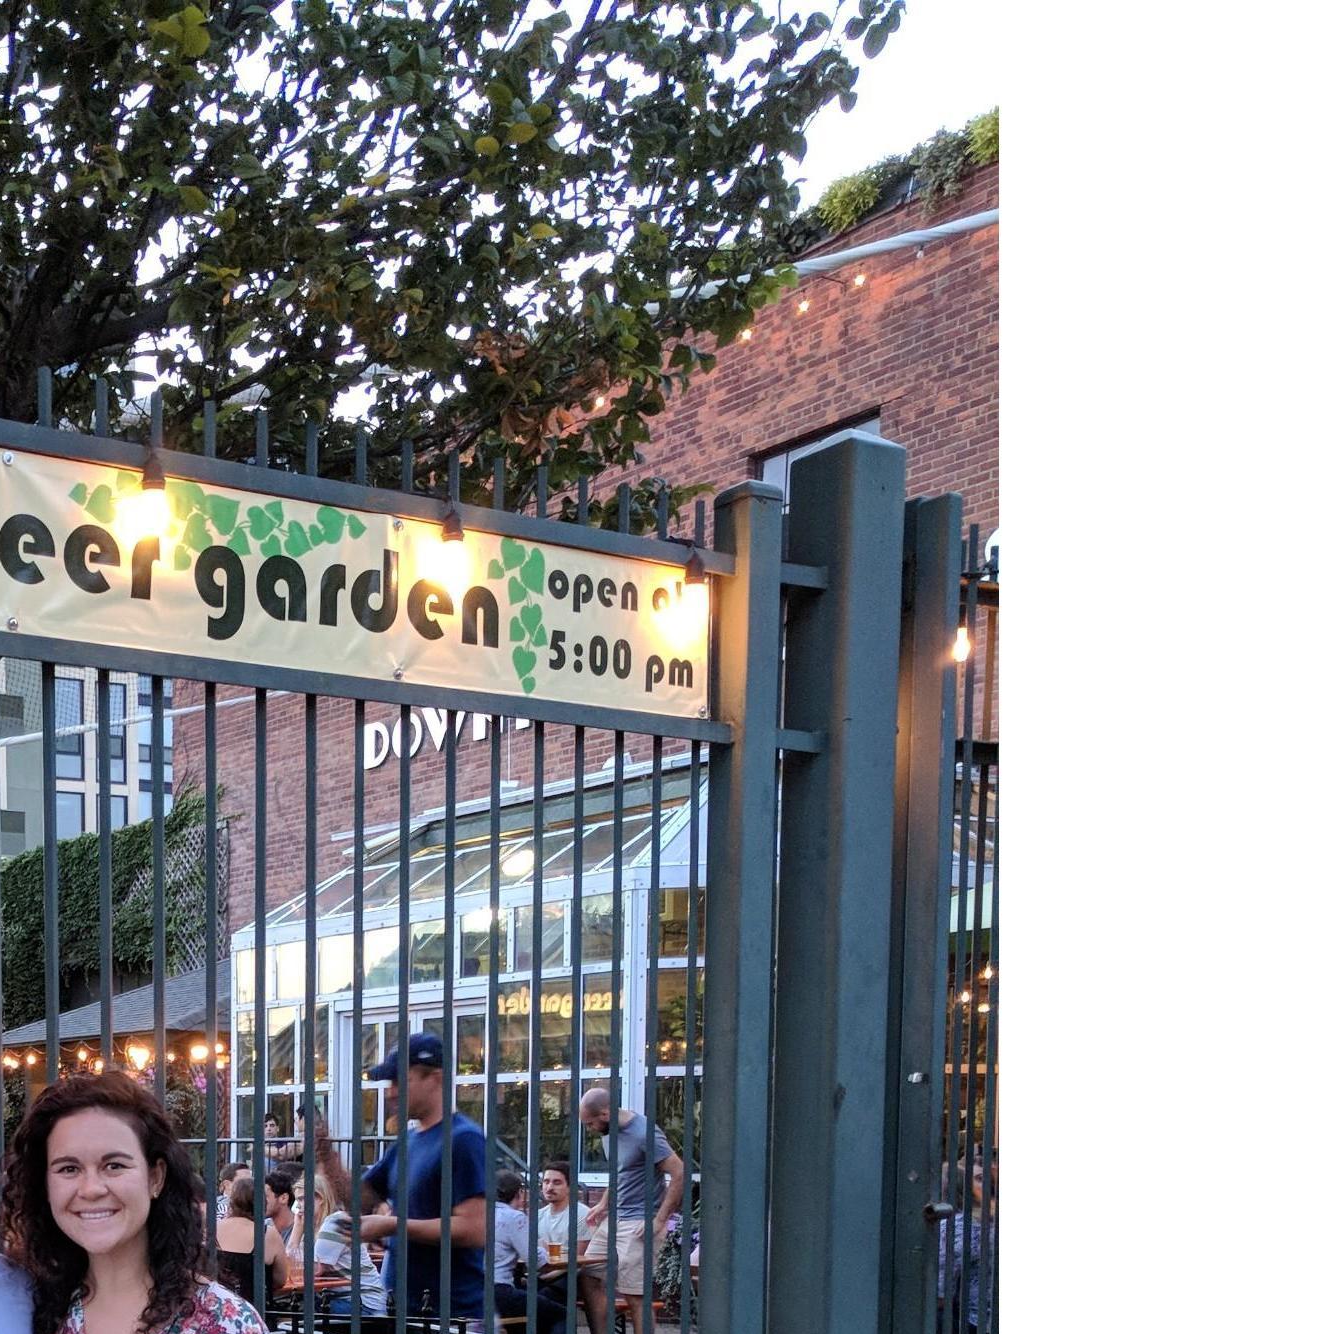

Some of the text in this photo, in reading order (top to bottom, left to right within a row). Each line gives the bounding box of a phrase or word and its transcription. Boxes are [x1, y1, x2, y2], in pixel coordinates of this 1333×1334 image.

[194, 545, 500, 648] garden
[548, 569, 638, 613] open
[549, 629, 693, 692] 5:00 pm
